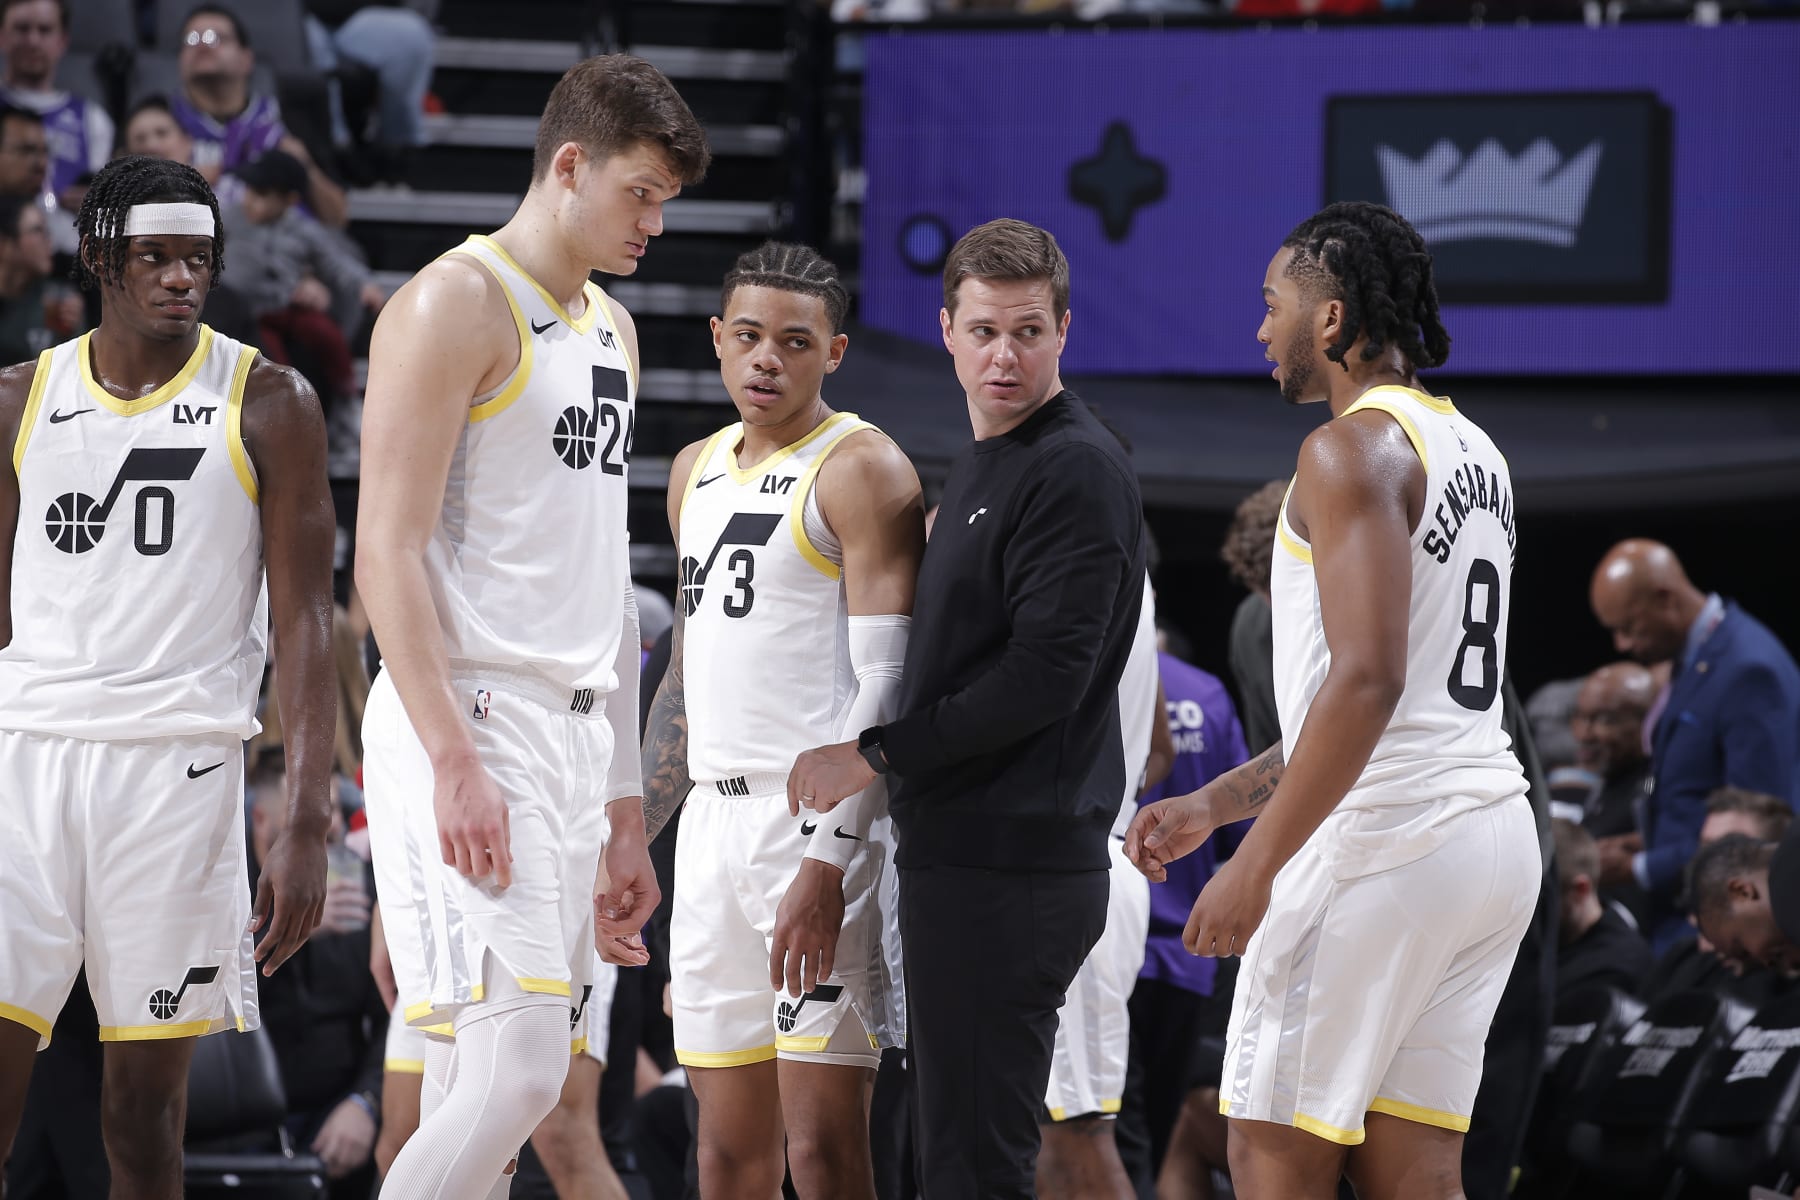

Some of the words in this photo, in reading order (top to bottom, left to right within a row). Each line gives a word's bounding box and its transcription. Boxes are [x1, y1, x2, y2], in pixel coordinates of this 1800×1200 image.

[173, 404, 217, 424] LVT
[600, 403, 635, 476] 24
[760, 474, 798, 495] LVT
[1423, 463, 1515, 572] SENSABAUG
[134, 486, 174, 555] 0
[723, 549, 755, 618] 3
[1447, 558, 1500, 711] 8
[716, 776, 750, 796] UTAH
